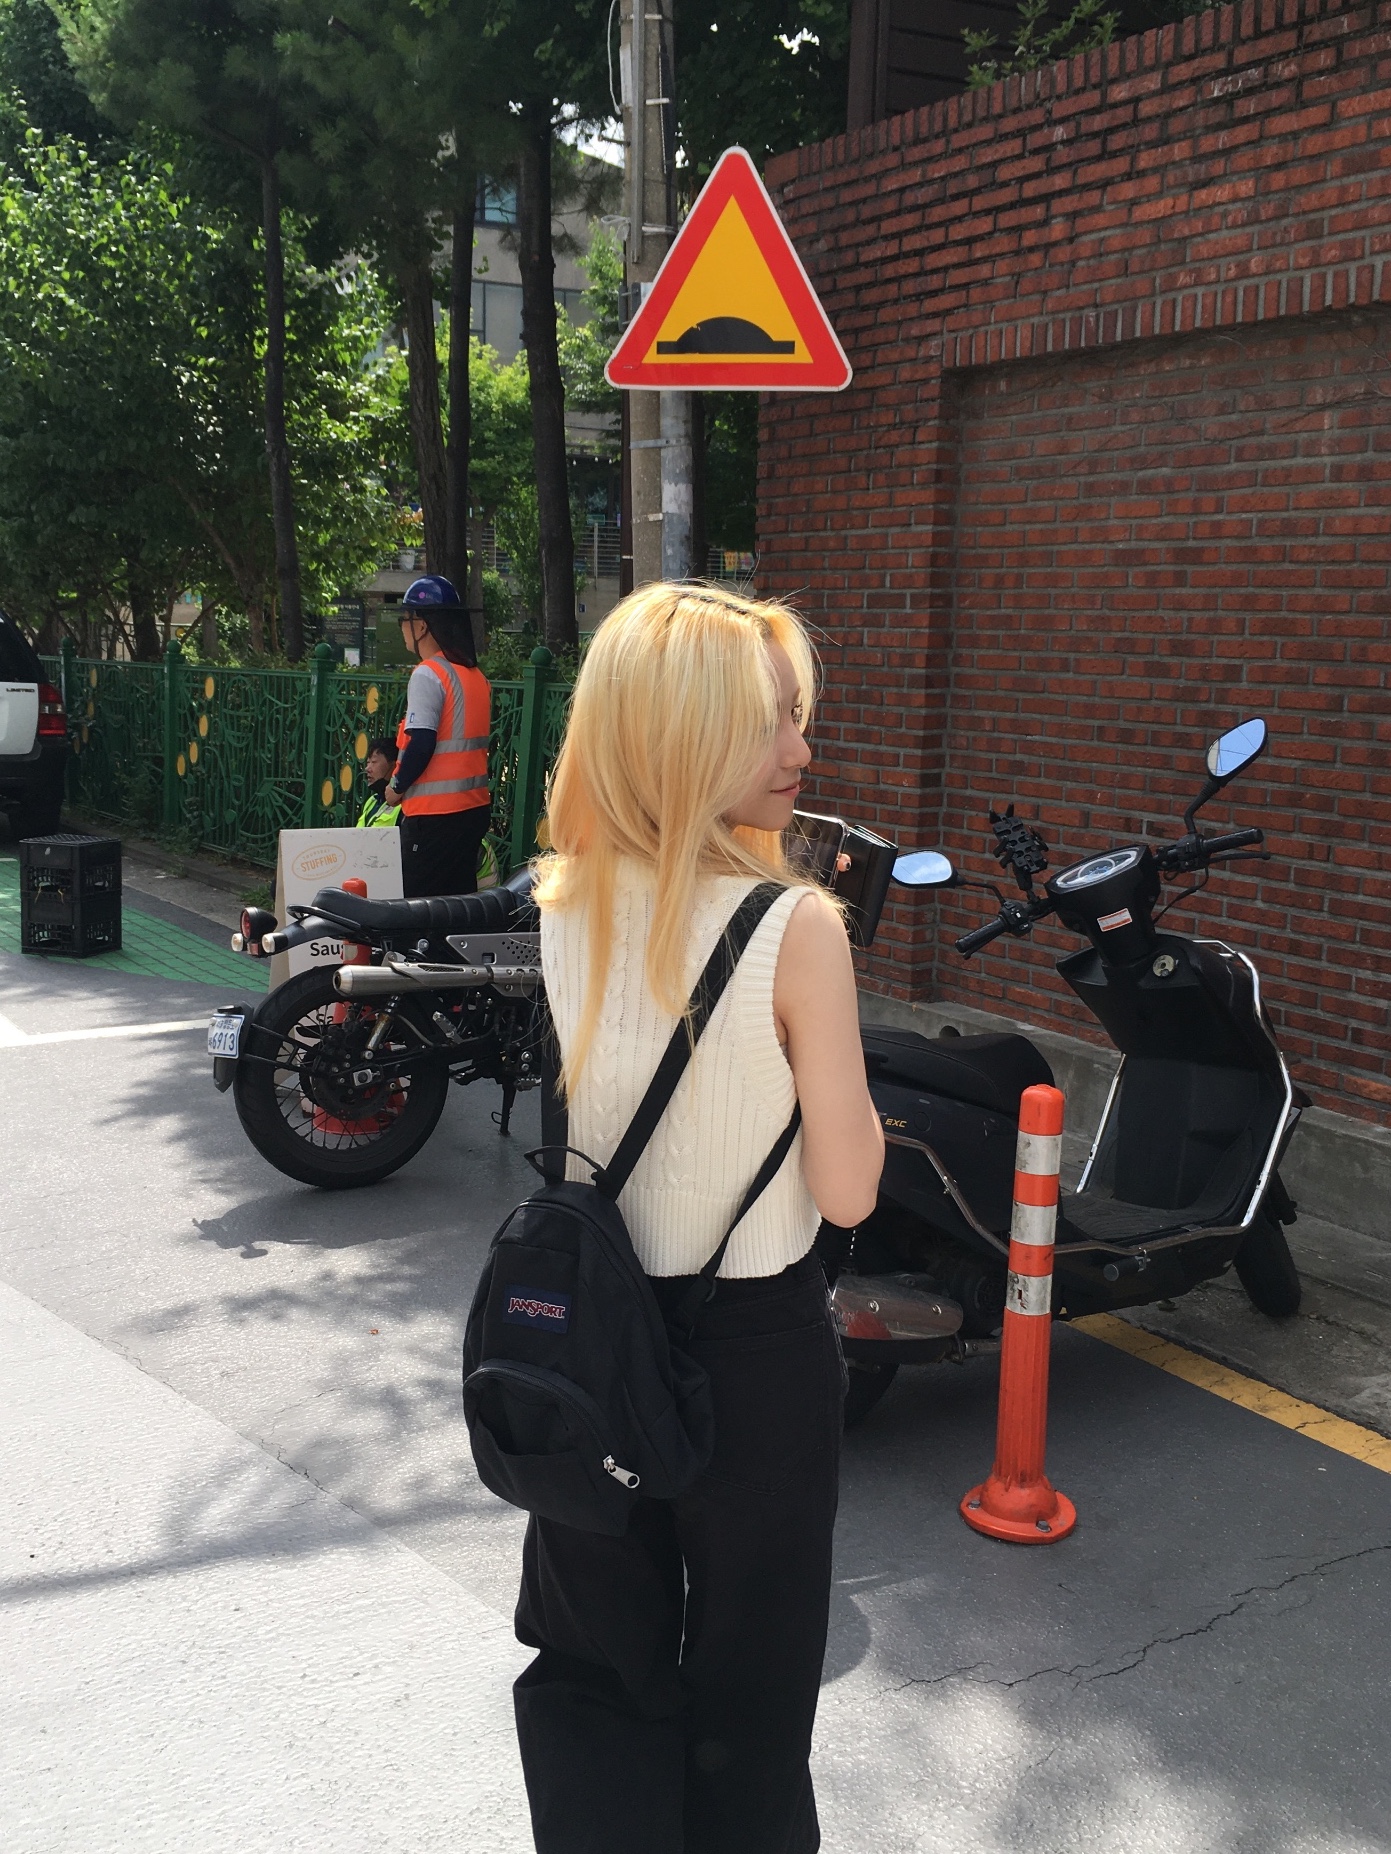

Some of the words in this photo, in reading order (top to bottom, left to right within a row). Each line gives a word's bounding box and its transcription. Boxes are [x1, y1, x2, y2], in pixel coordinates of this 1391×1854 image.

[301, 853, 338, 872] STUFFING
[212, 1032, 235, 1051] 6913
[885, 1118, 907, 1128] EXC
[508, 1297, 566, 1318] JANSPORT
